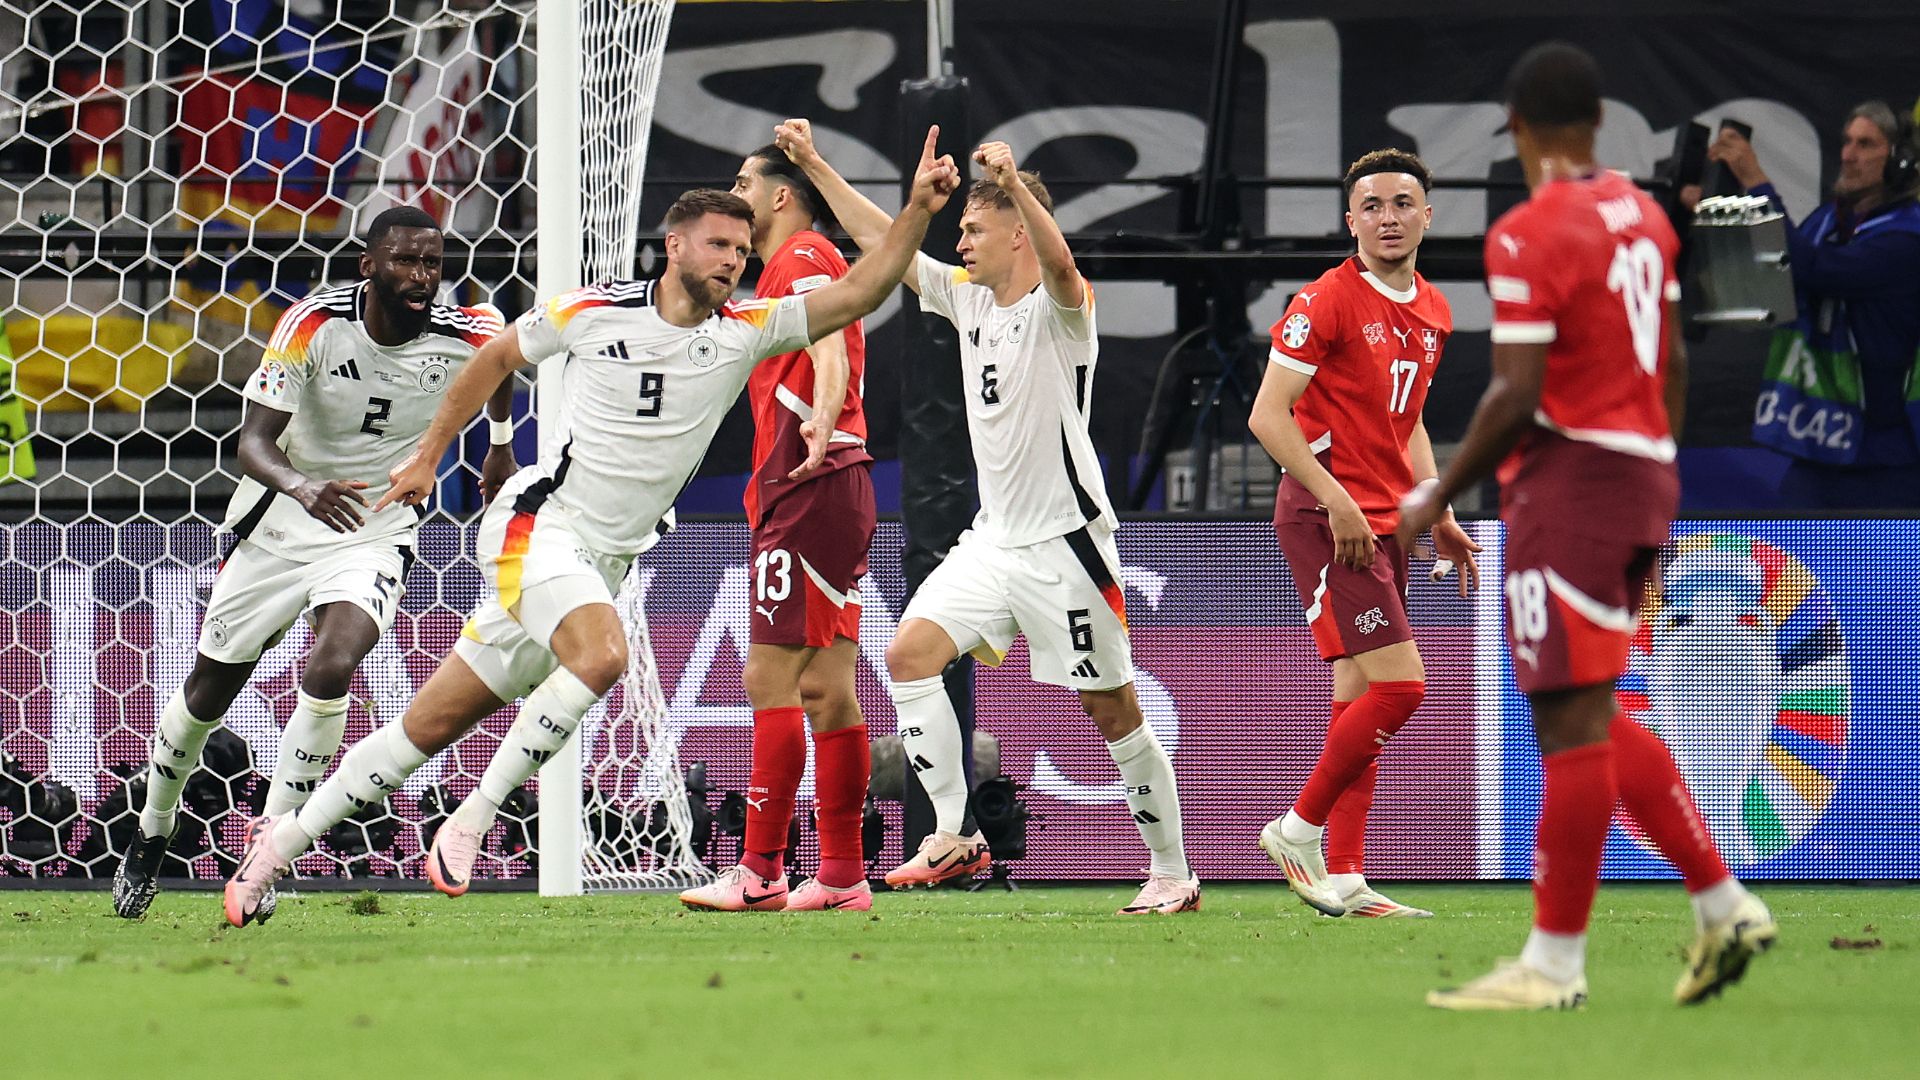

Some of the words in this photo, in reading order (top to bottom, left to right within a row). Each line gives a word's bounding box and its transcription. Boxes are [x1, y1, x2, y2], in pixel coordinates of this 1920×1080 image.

[636, 371, 665, 419] 9
[981, 363, 1001, 407] 6
[1389, 358, 1419, 414] 17
[360, 396, 394, 438] 2
[754, 548, 792, 602] 13
[1505, 567, 1548, 642] 18
[1066, 608, 1096, 653] 6
[158, 726, 186, 759] DFB
[900, 726, 924, 741] FB
[295, 747, 333, 765] DFB
[1126, 784, 1152, 796] FB
